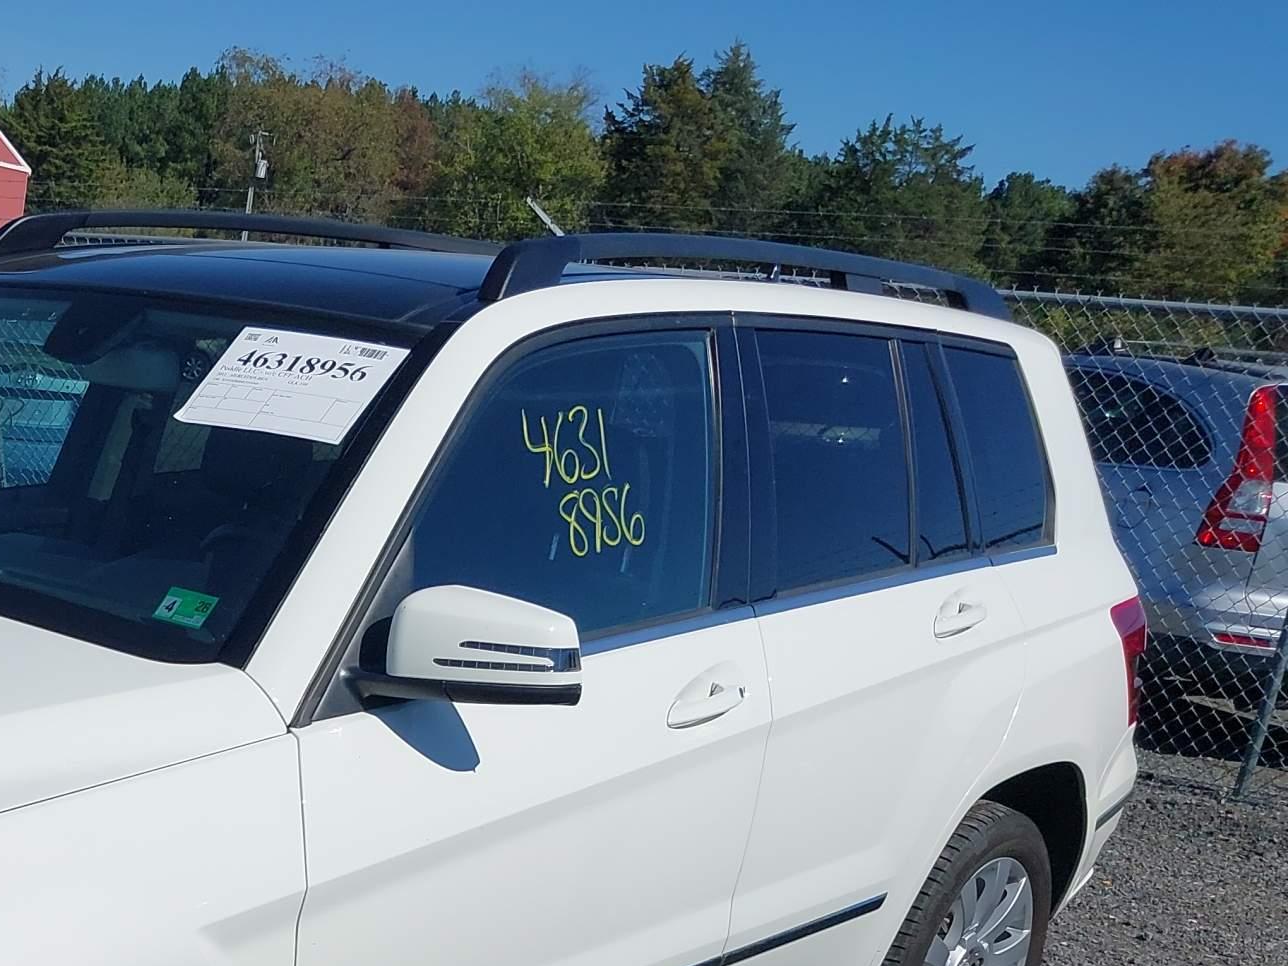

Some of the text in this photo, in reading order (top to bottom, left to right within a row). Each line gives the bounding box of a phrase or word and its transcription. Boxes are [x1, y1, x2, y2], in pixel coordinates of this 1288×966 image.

[236, 349, 376, 382] 46318956
[521, 405, 612, 489] 4631
[559, 482, 645, 557] 8956
[164, 600, 177, 613] 4
